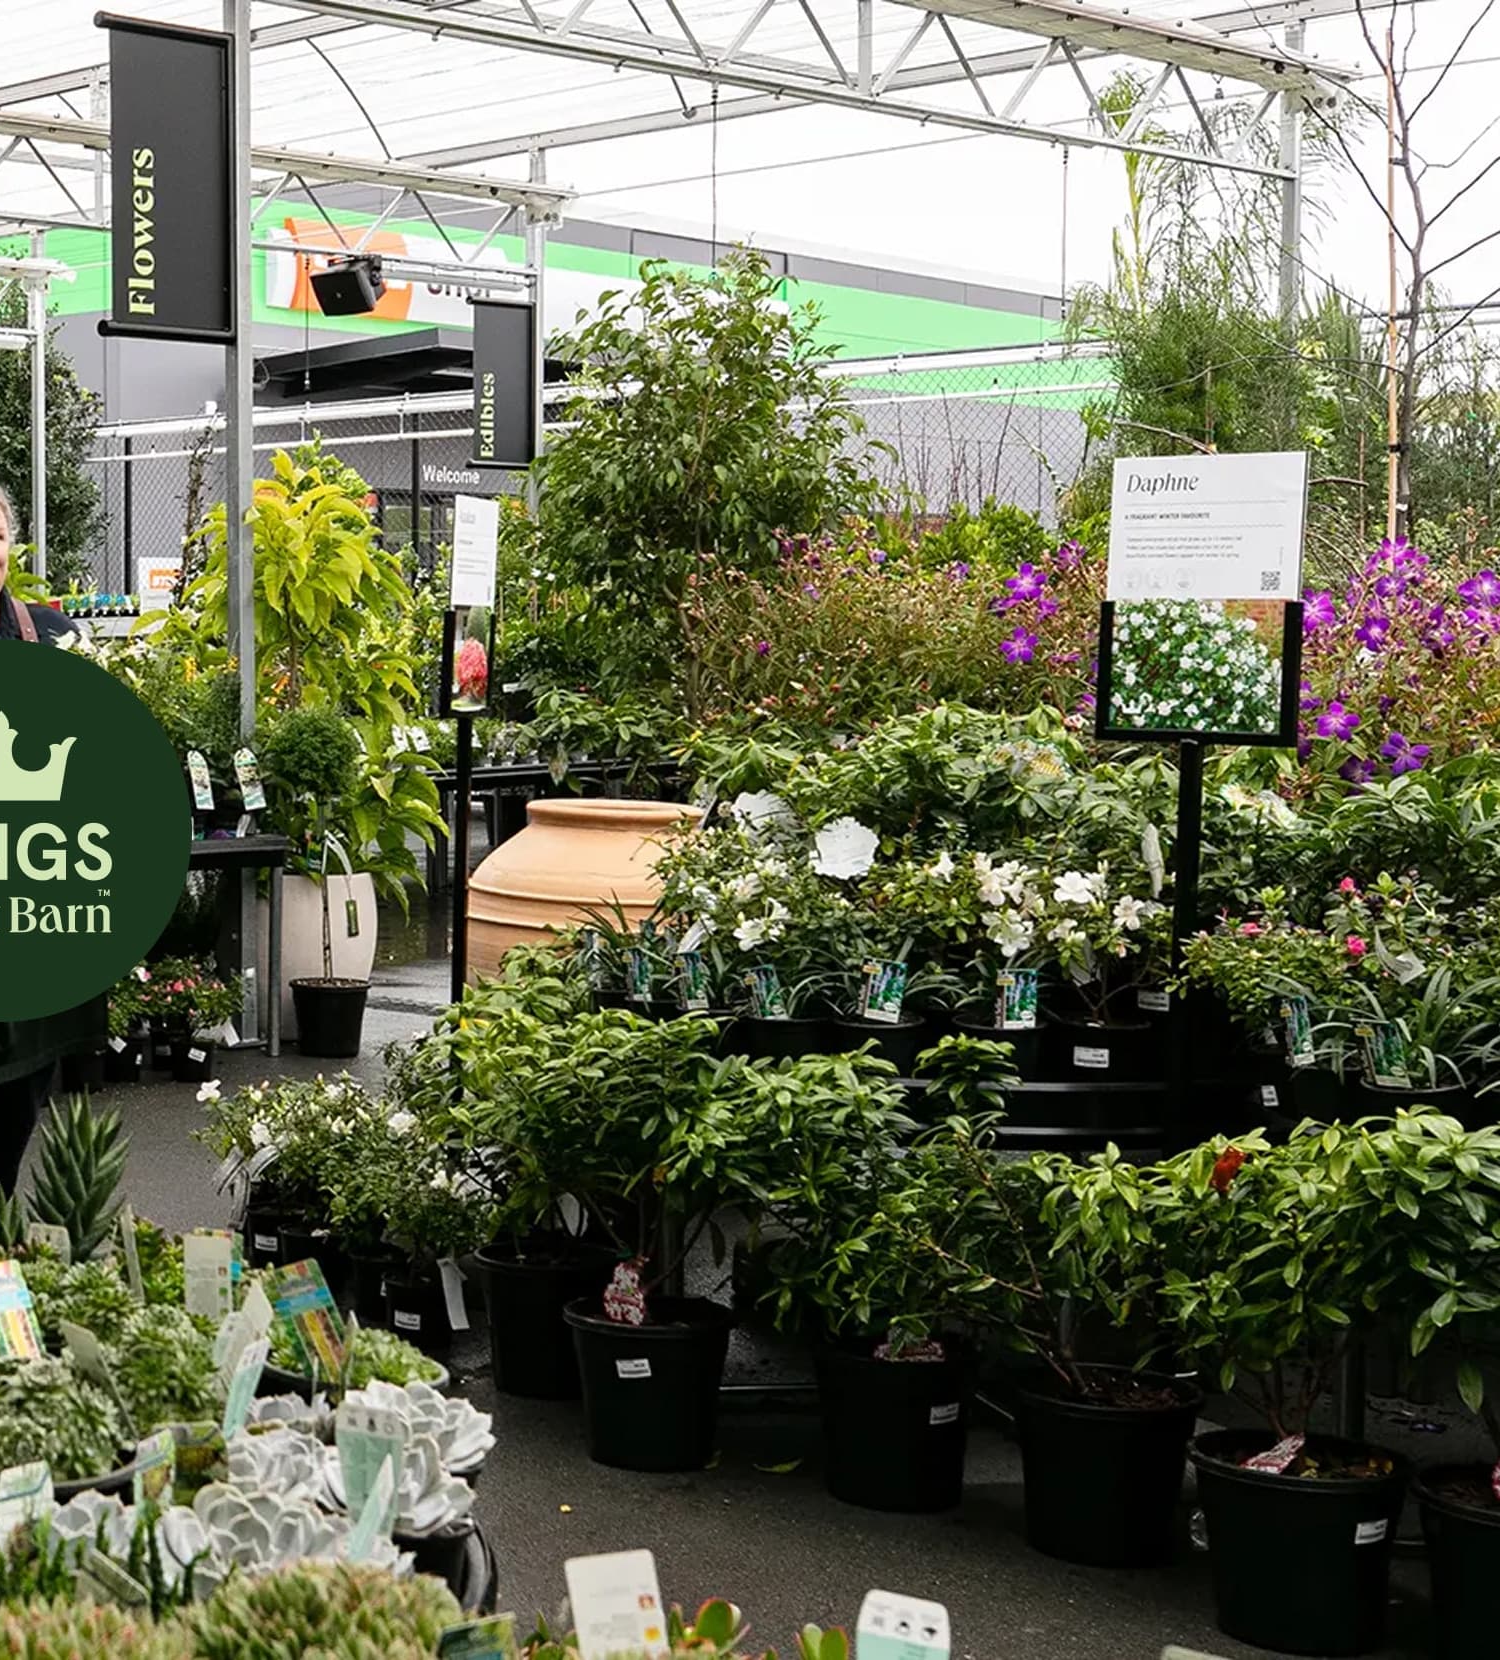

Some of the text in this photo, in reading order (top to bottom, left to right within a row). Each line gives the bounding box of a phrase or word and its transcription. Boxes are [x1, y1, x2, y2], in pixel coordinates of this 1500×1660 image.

[127, 147, 156, 315] Flowers
[480, 372, 495, 457] Edibles
[422, 464, 480, 484] Welcome
[1126, 472, 1200, 496] Daphne
